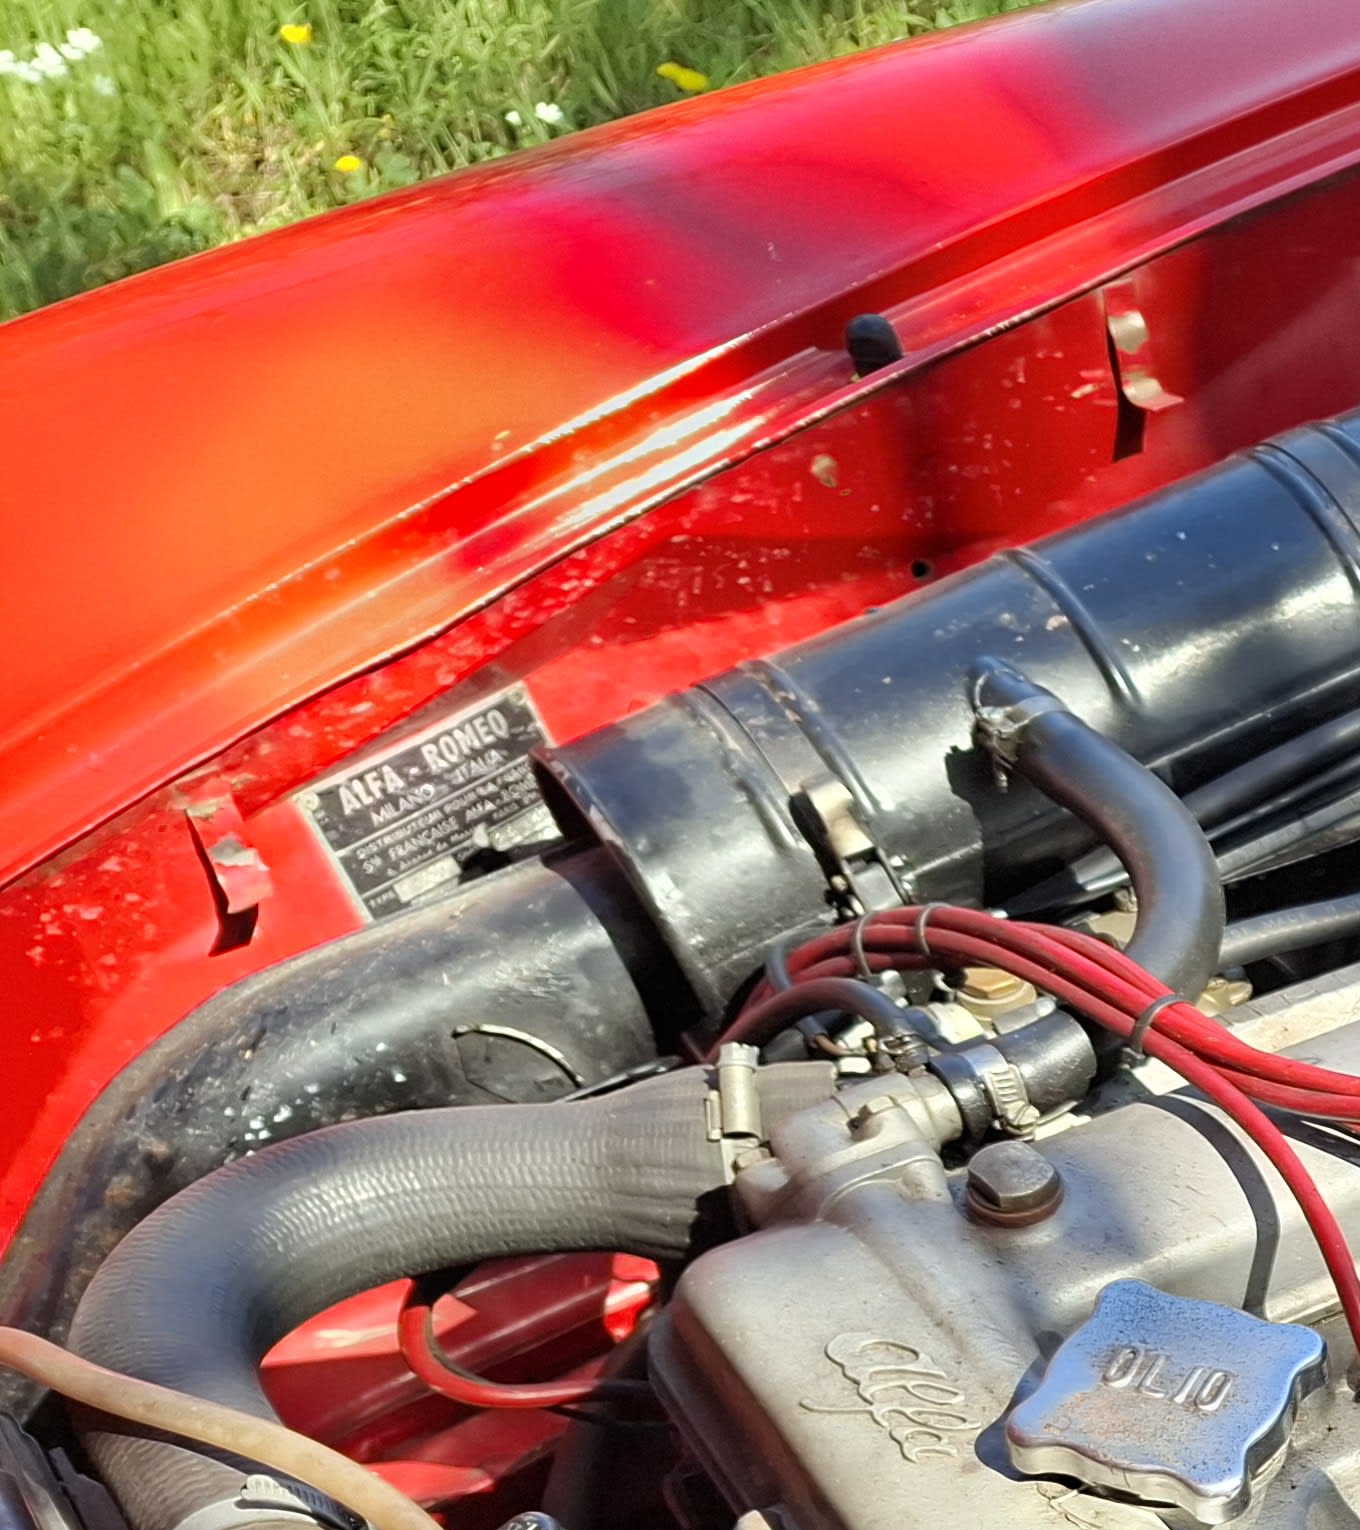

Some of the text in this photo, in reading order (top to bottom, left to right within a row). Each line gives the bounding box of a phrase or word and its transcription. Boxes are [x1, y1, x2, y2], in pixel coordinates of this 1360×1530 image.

[339, 765, 403, 813] ALFA
[421, 712, 505, 770] ROMEO
[370, 783, 435, 825] MILANO
[799, 1331, 982, 1463] Alfa
[1101, 1345, 1234, 1413] OLIO
